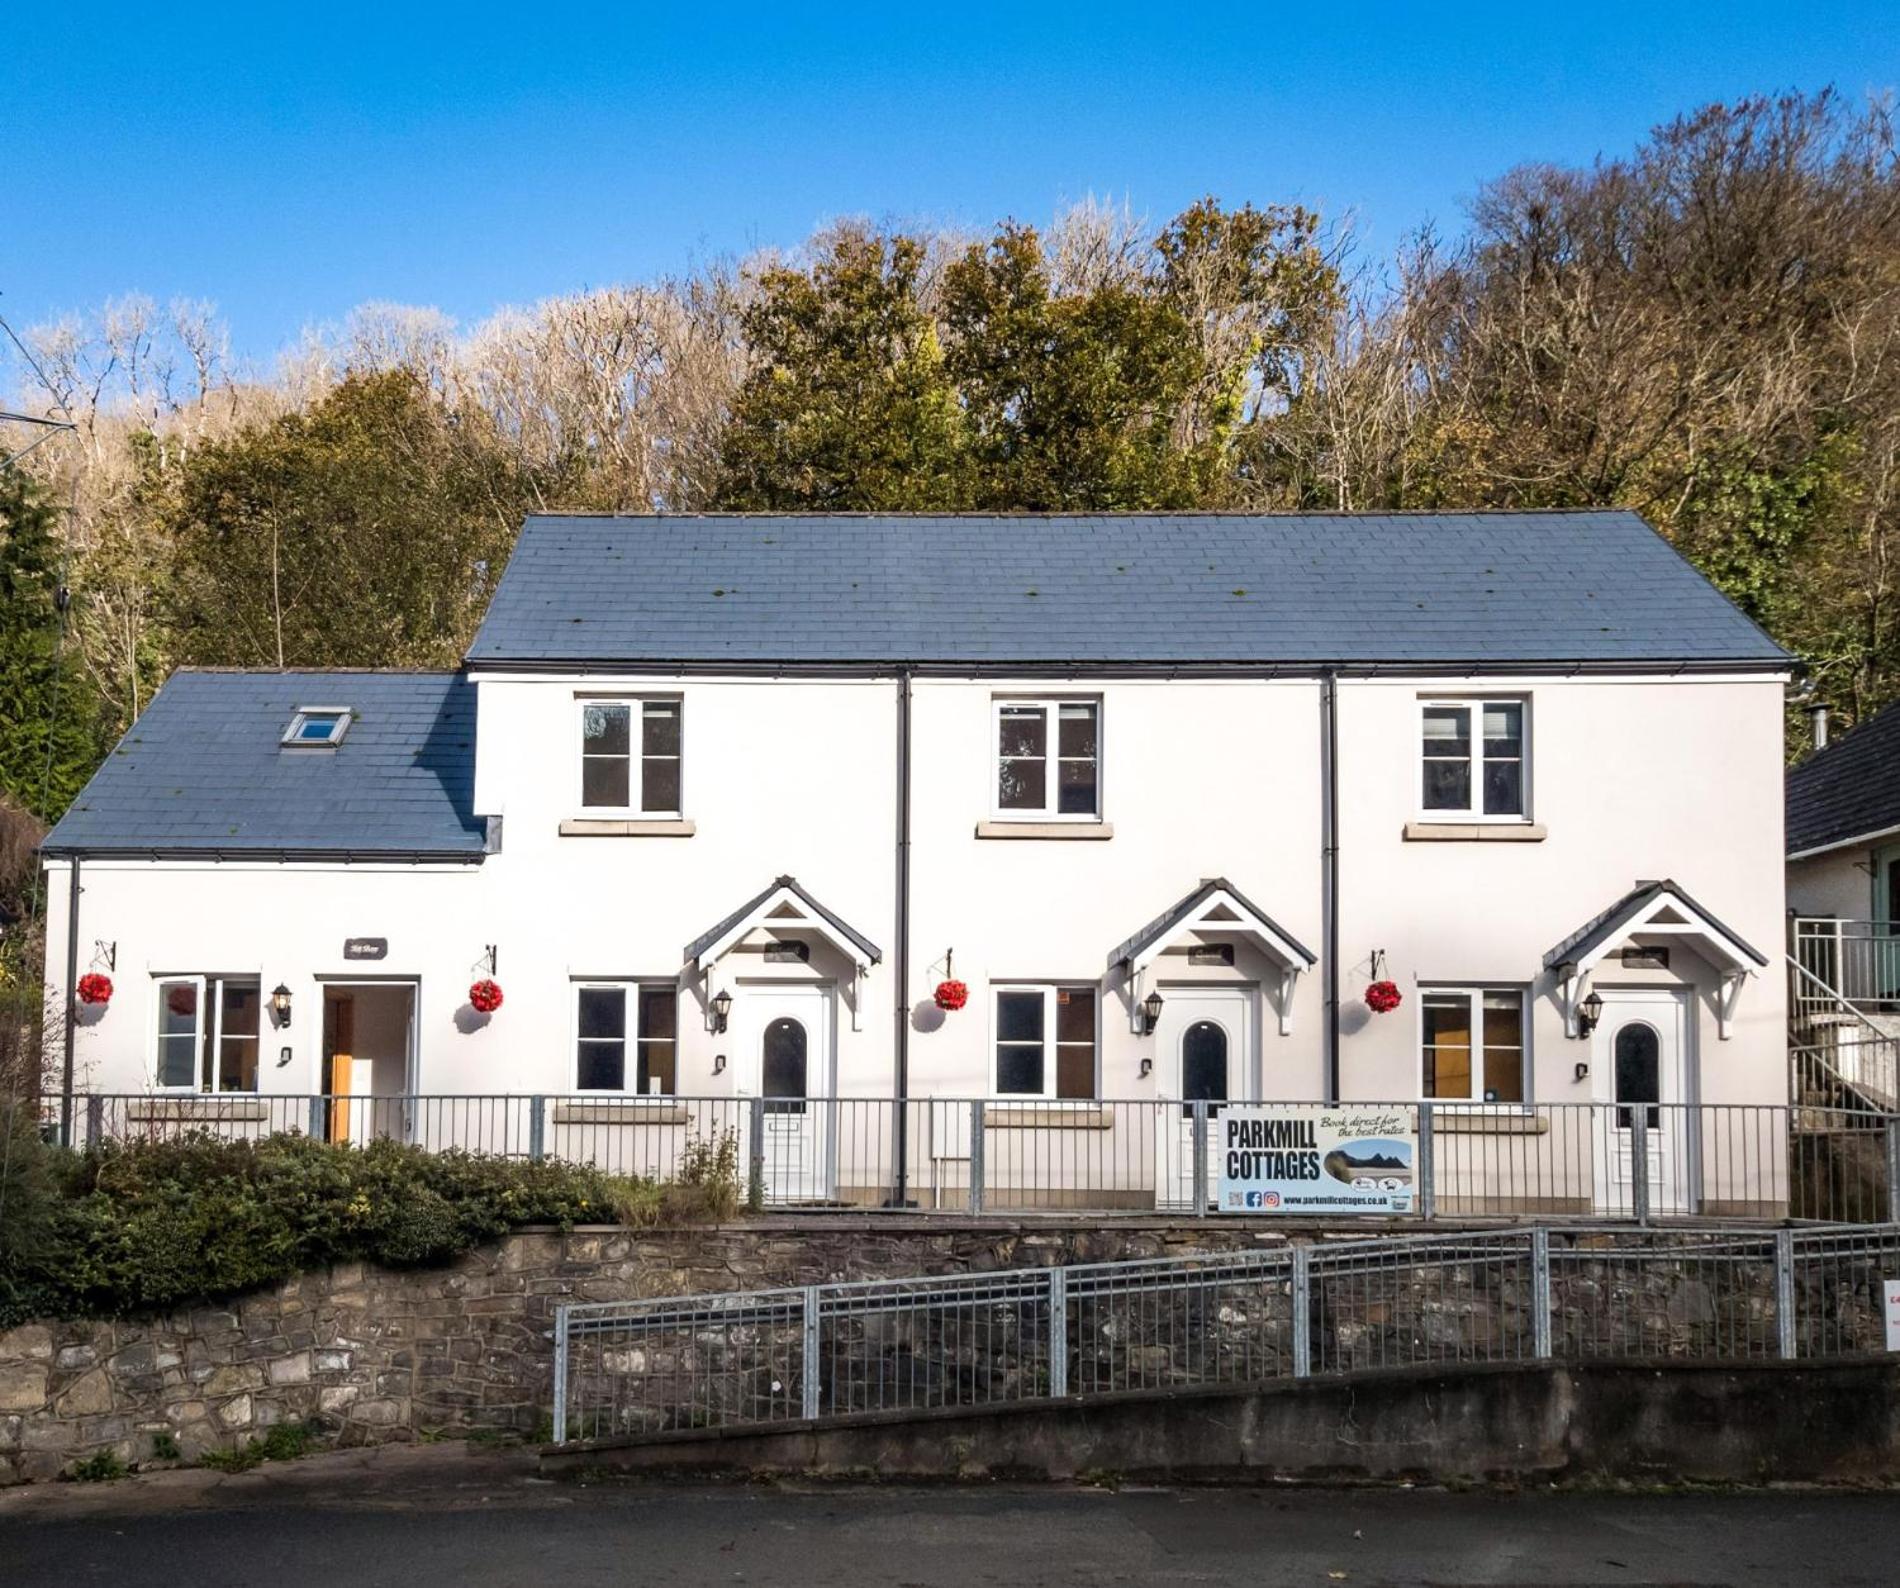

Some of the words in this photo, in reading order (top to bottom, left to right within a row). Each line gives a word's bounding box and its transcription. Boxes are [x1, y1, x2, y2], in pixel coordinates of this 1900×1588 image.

[1320, 1116, 1346, 1127] Book
[1349, 1114, 1382, 1127] direct
[1381, 1113, 1400, 1127] for
[1227, 1119, 1317, 1149] PARKMILL
[1338, 1126, 1352, 1137] the
[1356, 1126, 1379, 1137] best
[1378, 1125, 1405, 1136] rates
[1226, 1150, 1320, 1181] COTTAGES
[1283, 1195, 1388, 1206] www.parkmillcottages.co.uk
